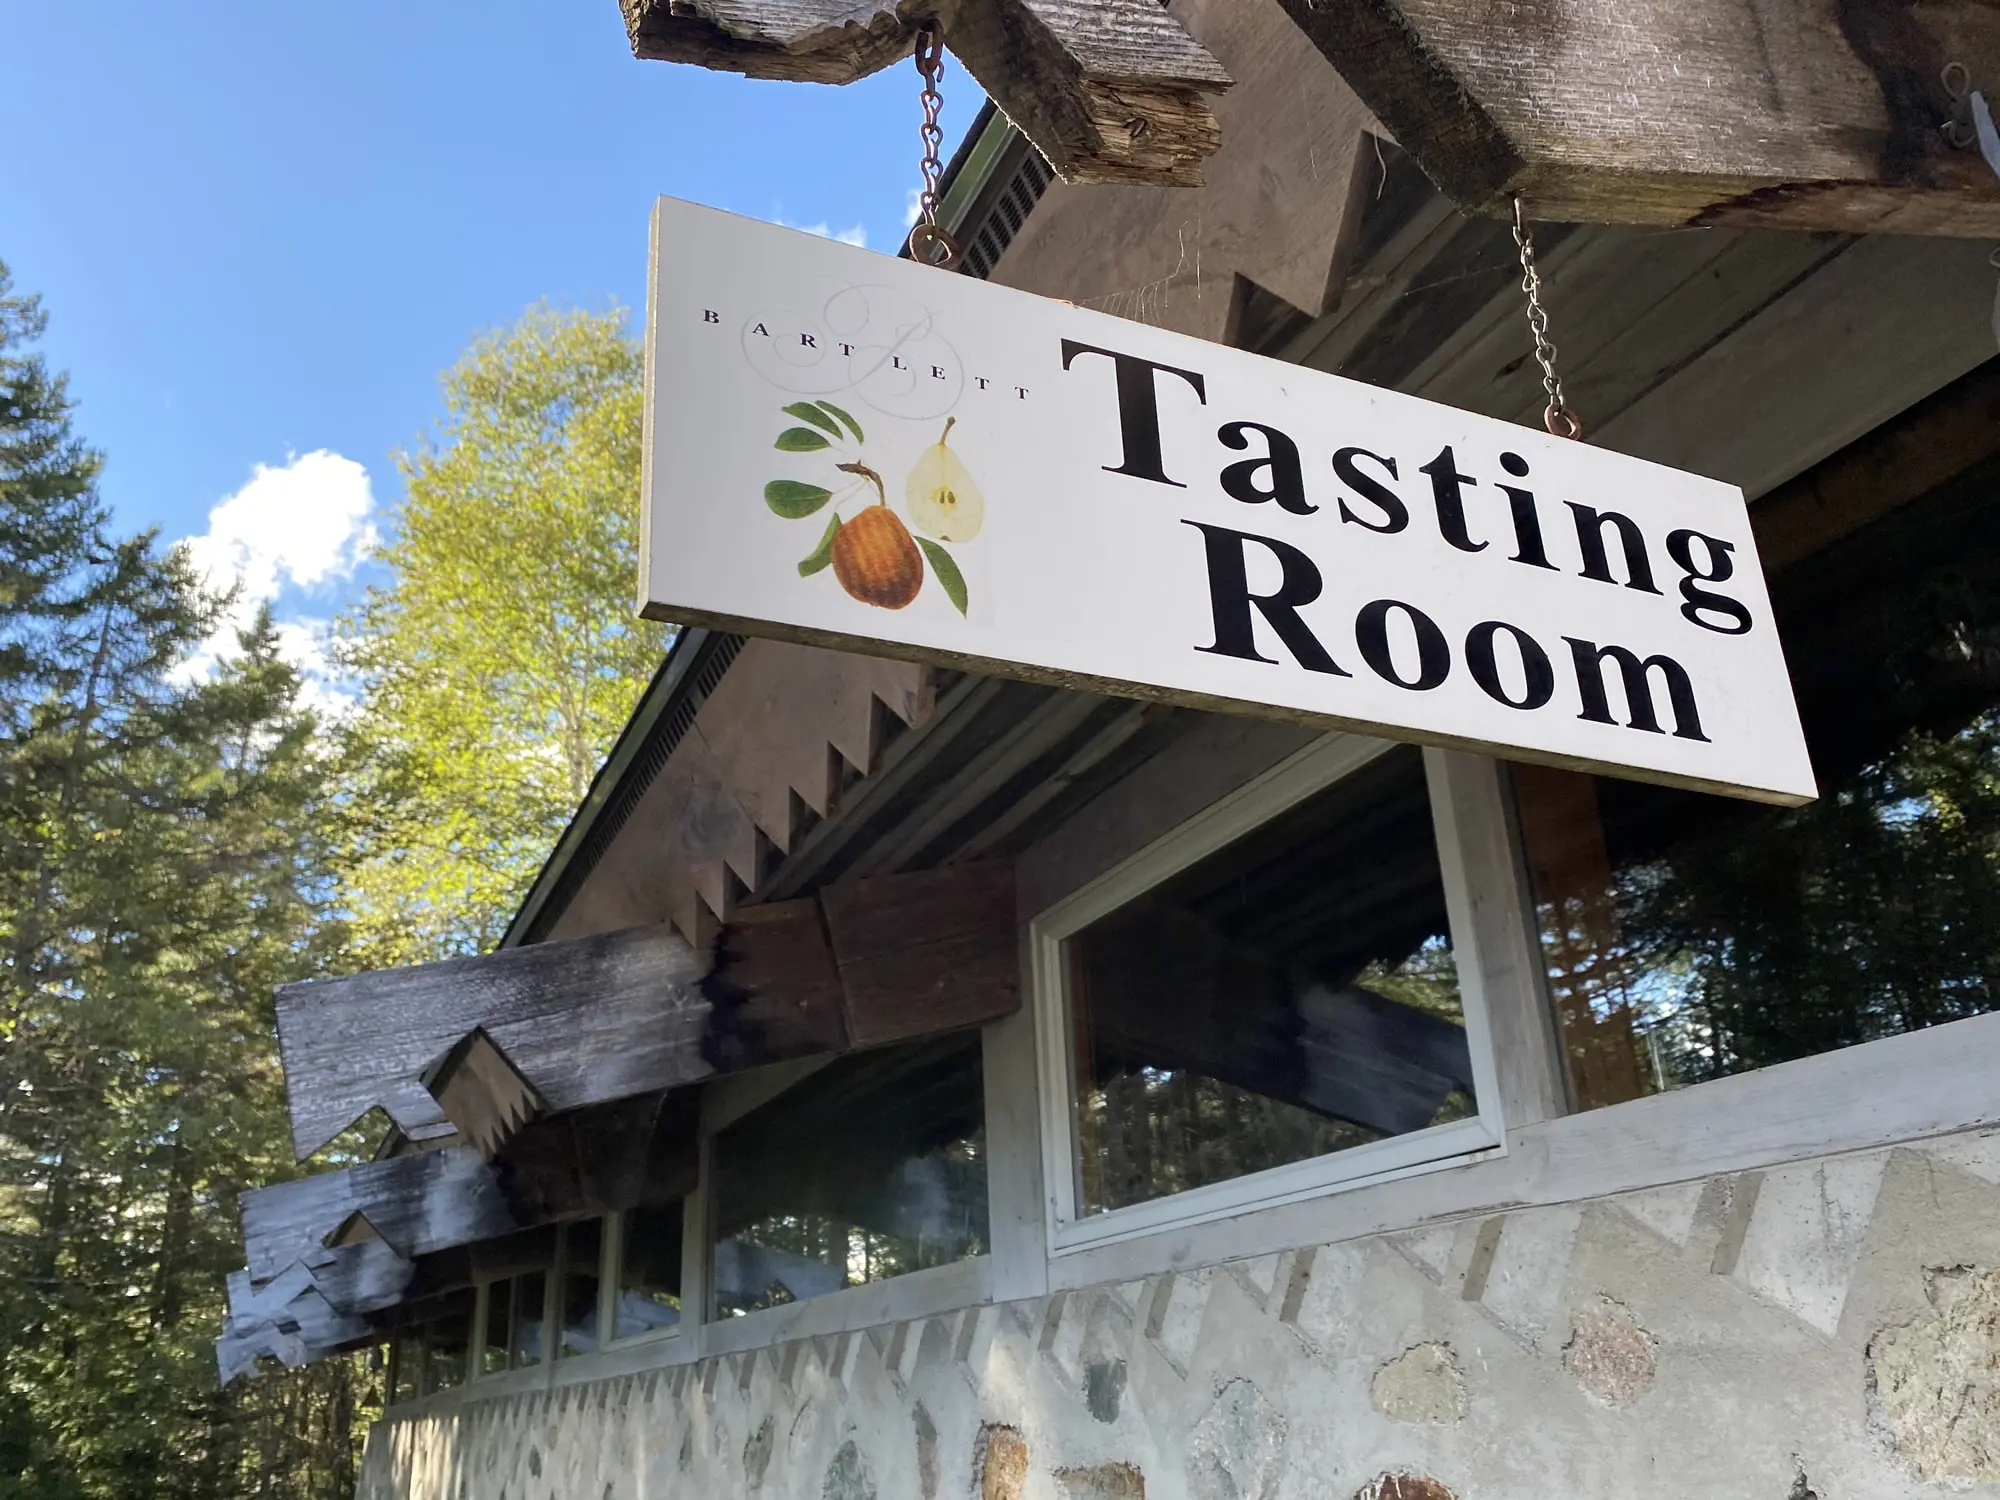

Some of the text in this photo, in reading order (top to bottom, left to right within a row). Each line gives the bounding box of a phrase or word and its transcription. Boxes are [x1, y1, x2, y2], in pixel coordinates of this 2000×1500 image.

[703, 309, 1028, 400] BARTLETT
[1061, 338, 1752, 634] Tasting
[1180, 519, 1712, 743] Room
